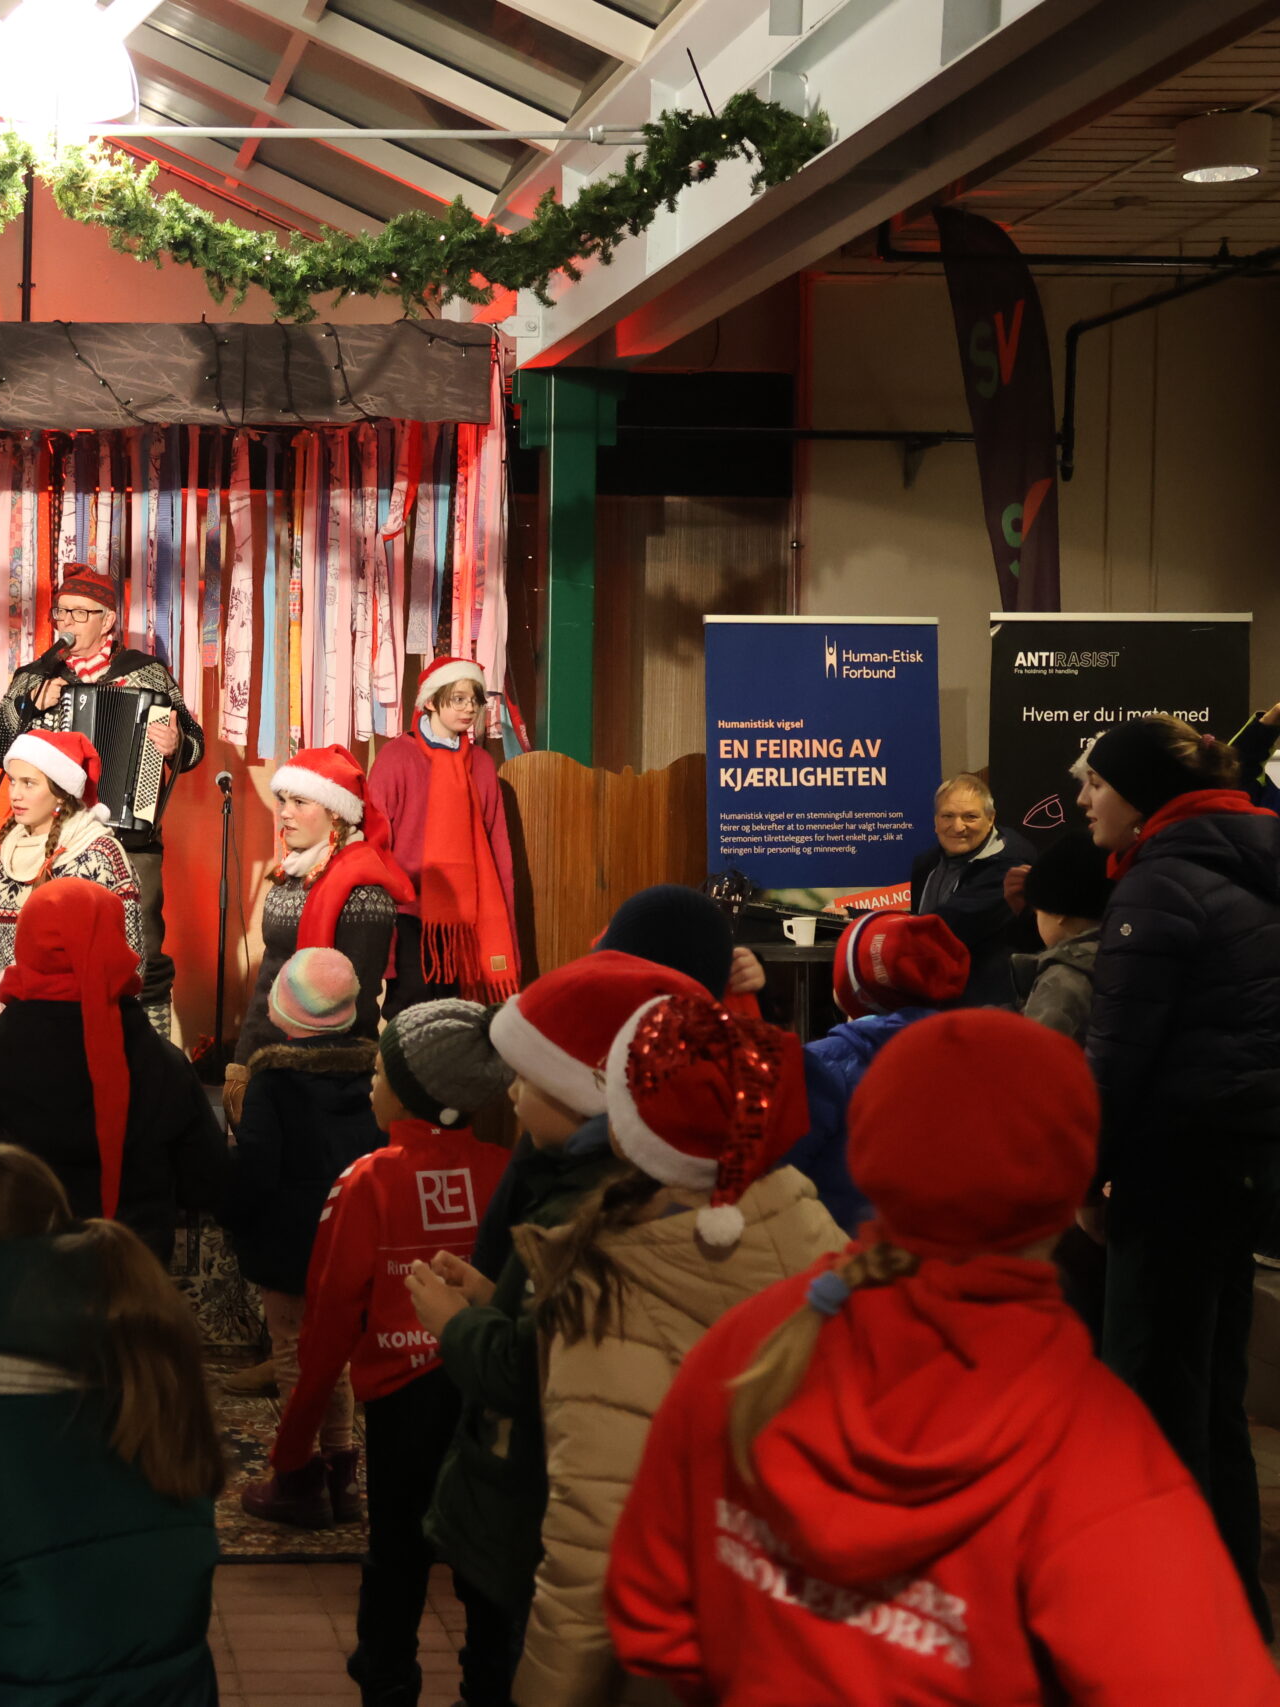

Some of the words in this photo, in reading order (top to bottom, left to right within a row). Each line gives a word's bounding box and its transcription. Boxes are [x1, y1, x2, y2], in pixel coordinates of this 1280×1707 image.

[842, 649, 924, 663] Human-Etisk
[1014, 651, 1120, 668] ANTIRASIST
[842, 666, 896, 679] Forbund
[1024, 668, 1048, 676] holdning
[1055, 668, 1079, 676] handling
[1023, 707, 1069, 722] Hvem
[1073, 711, 1090, 722] er
[1094, 707, 1115, 722] du
[1119, 706, 1123, 722] i
[1173, 707, 1209, 722] med
[718, 719, 775, 729] Humanistisk
[777, 718, 804, 731] vigsel
[720, 740, 749, 759] EN
[756, 739, 844, 759] FEIRING
[850, 739, 882, 758] AV
[720, 767, 887, 792] KJÆRLIGHETEN
[720, 811, 763, 820] Humanistisk
[765, 811, 785, 822] vigsel
[807, 811, 854, 821] stemningsfull
[854, 811, 888, 819] seremoni
[720, 823, 741, 832] feirer
[742, 824, 751, 833] og
[752, 822, 786, 832] bekrefter
[787, 823, 795, 831] at
[806, 822, 844, 831] mennesker
[846, 822, 857, 830] har
[858, 822, 876, 832] valgt
[877, 821, 914, 830] hverandre.
[720, 834, 763, 843] Seremonien
[764, 834, 813, 844] tilrettelegges
[815, 833, 826, 842] for
[827, 833, 845, 842] hvert
[846, 833, 867, 842] enkelt
[868, 834, 882, 843] par,
[883, 832, 895, 841] slik
[896, 833, 903, 841] at
[720, 846, 753, 856] feiringen
[754, 845, 766, 854] blir
[767, 845, 801, 856] personlig
[802, 847, 812, 855] og
[813, 844, 857, 855] minneverdig.
